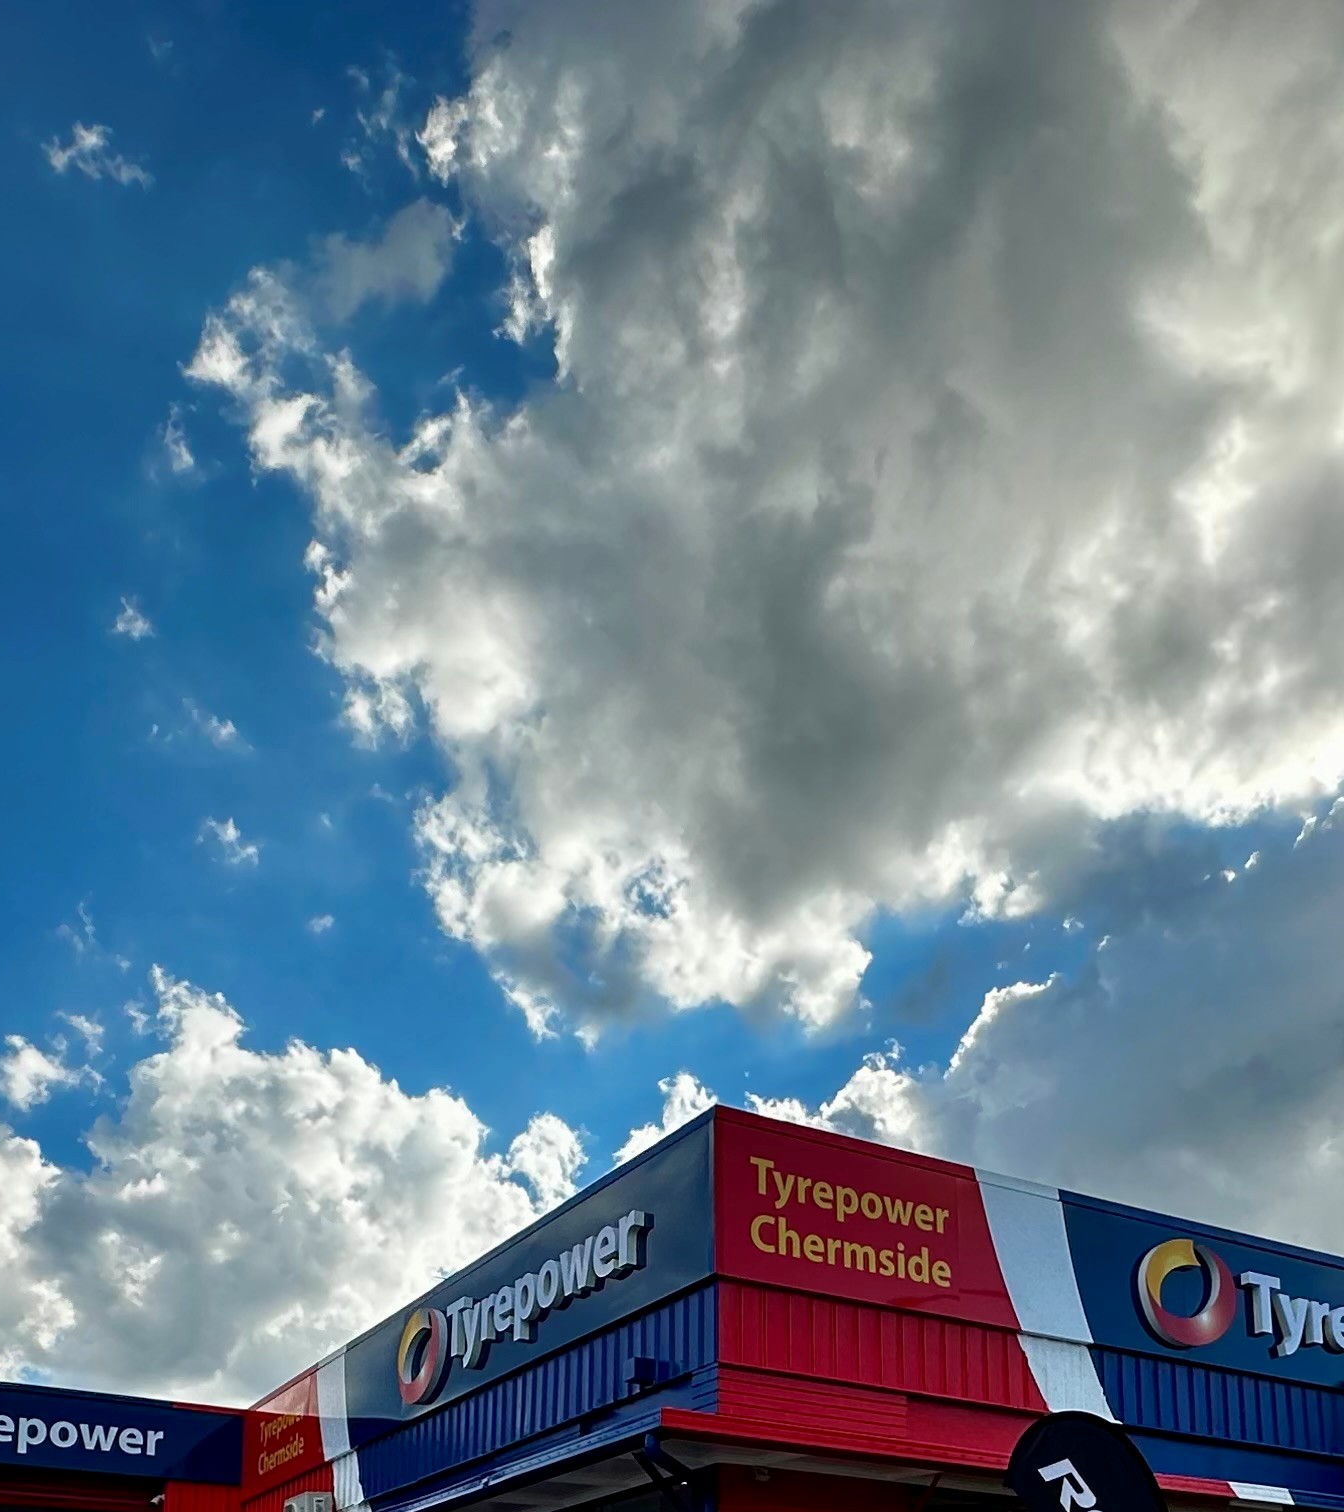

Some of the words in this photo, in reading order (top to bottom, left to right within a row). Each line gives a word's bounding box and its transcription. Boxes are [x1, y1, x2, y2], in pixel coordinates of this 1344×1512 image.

[750, 1156, 950, 1234] Tyrepower
[445, 1209, 646, 1369] Tyrepower
[750, 1214, 952, 1288] Chermside
[258, 1432, 304, 1475] Chermside
